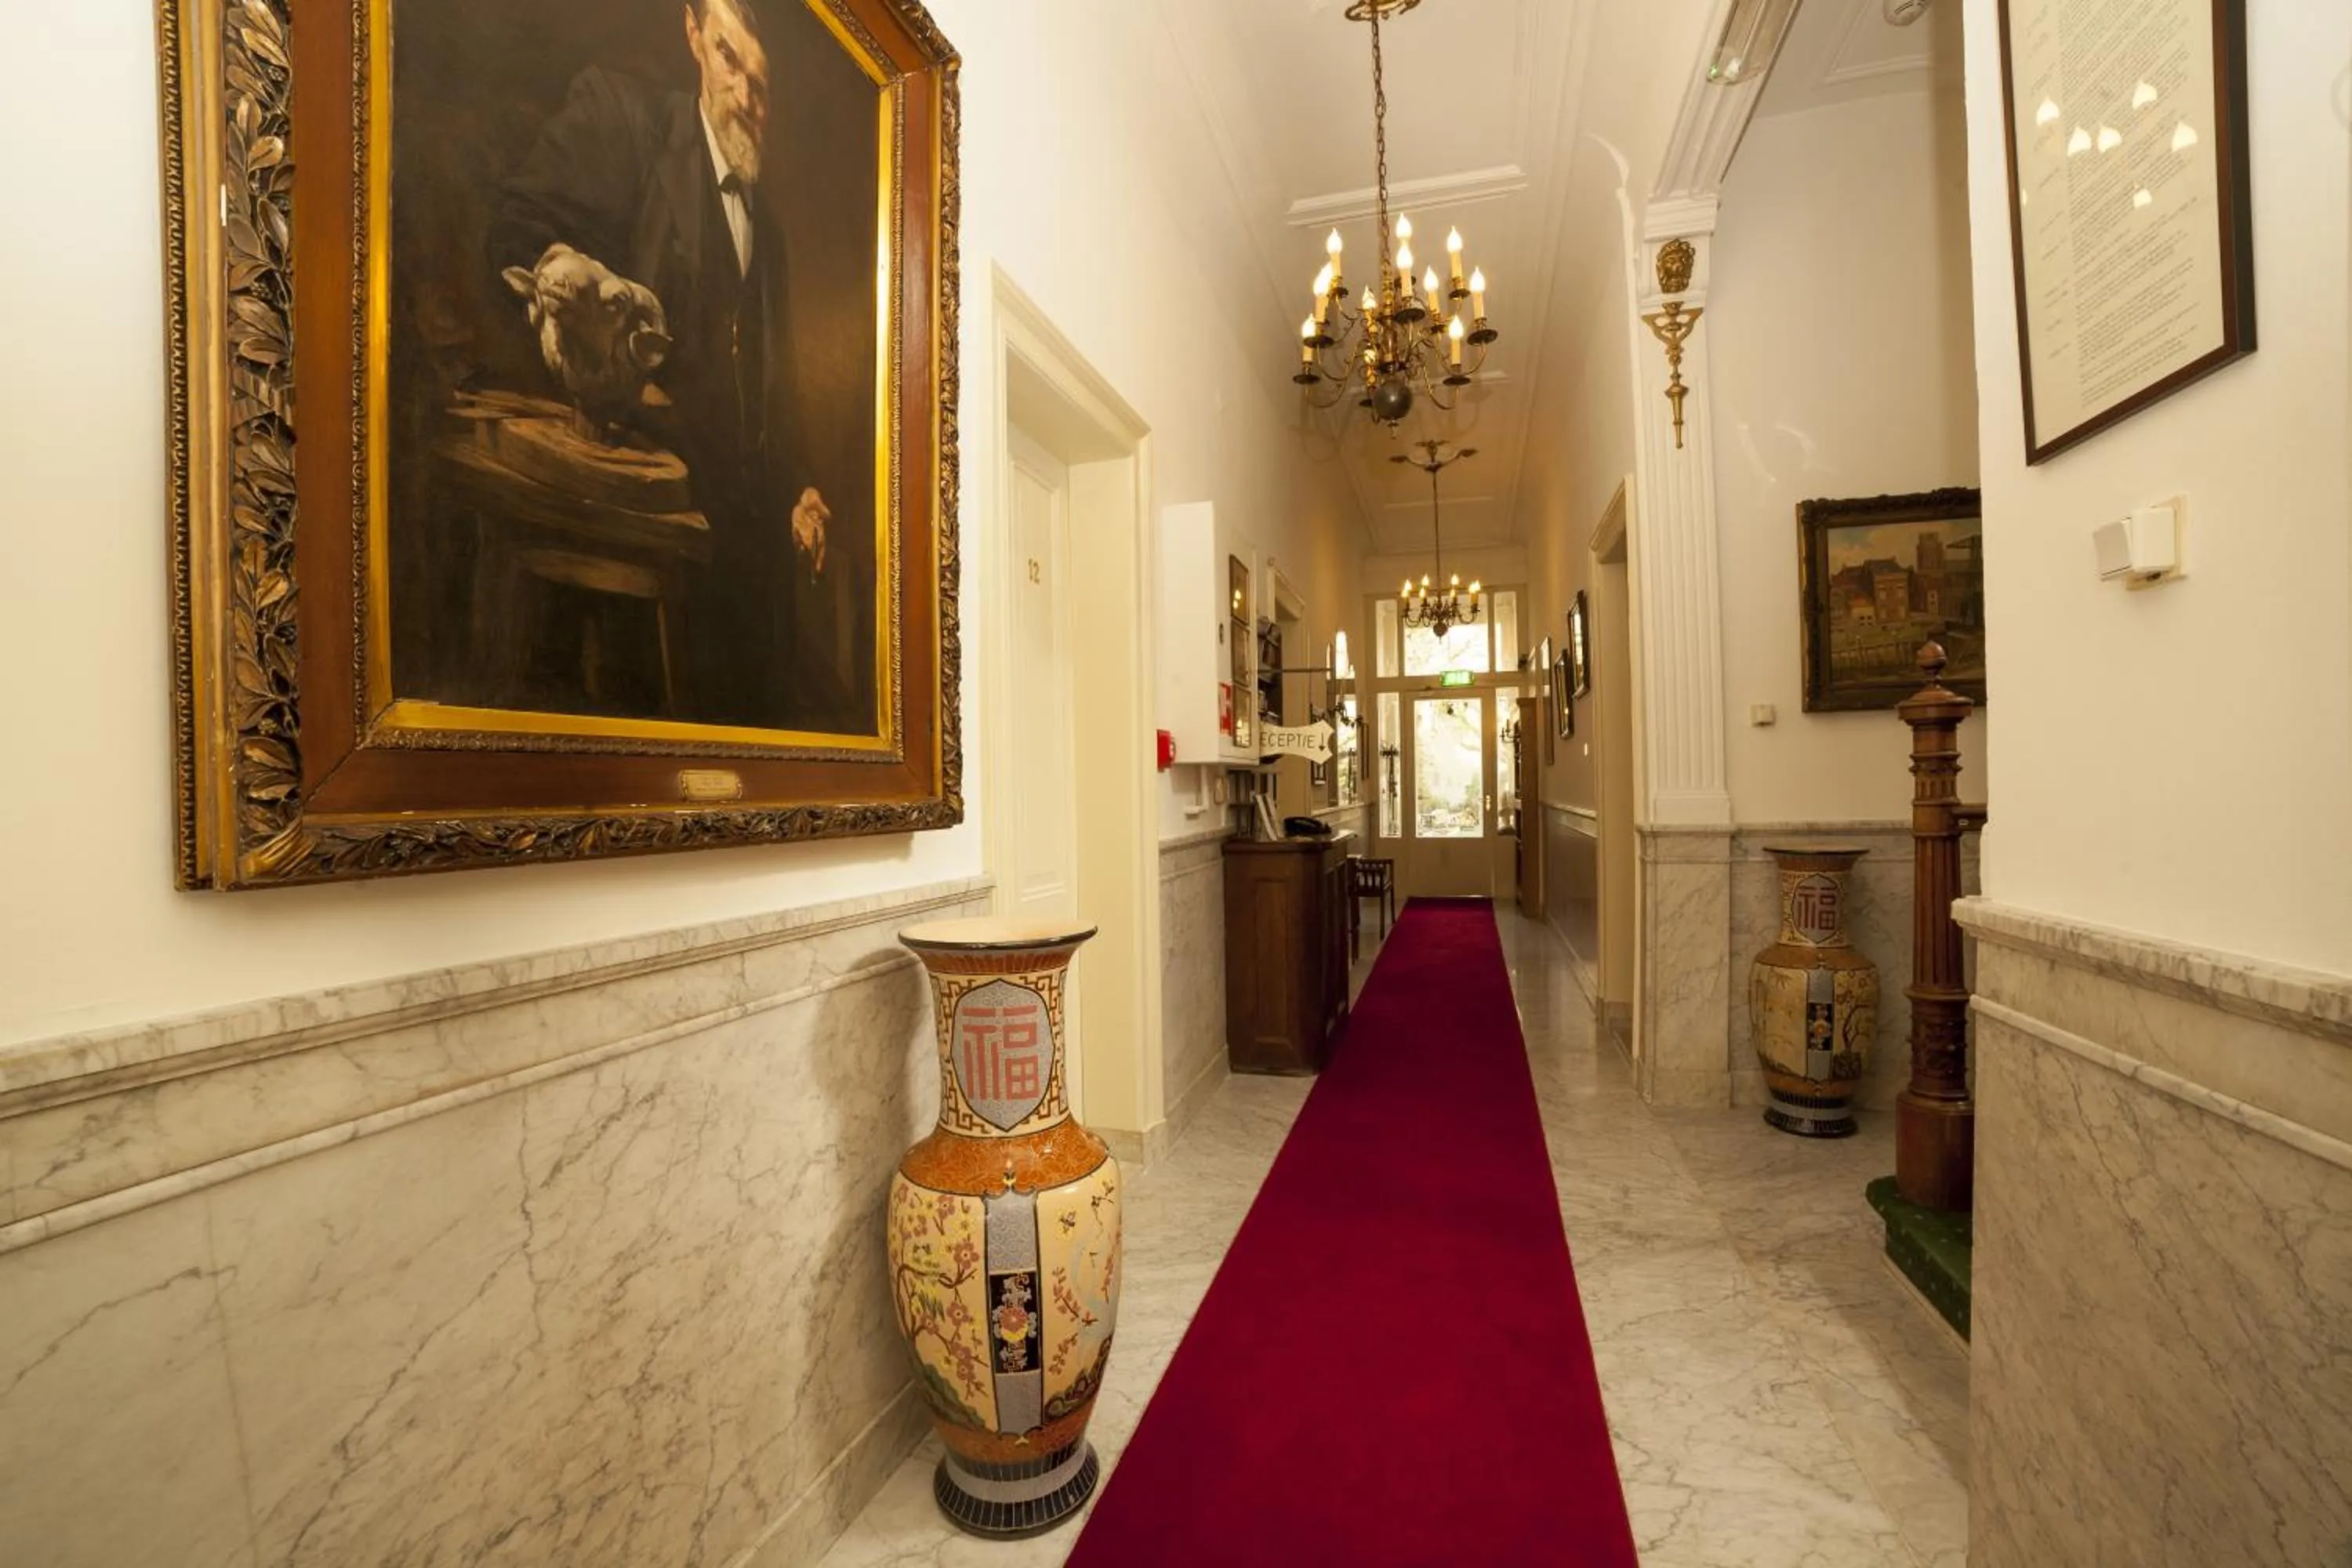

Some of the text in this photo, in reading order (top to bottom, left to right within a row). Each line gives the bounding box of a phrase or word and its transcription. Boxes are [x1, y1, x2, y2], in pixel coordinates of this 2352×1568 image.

[1028, 557, 1040, 585] 12
[1260, 731, 1316, 749] ECEPTIE
[1797, 886, 1838, 931] 福
[962, 1005, 1040, 1102] 福
